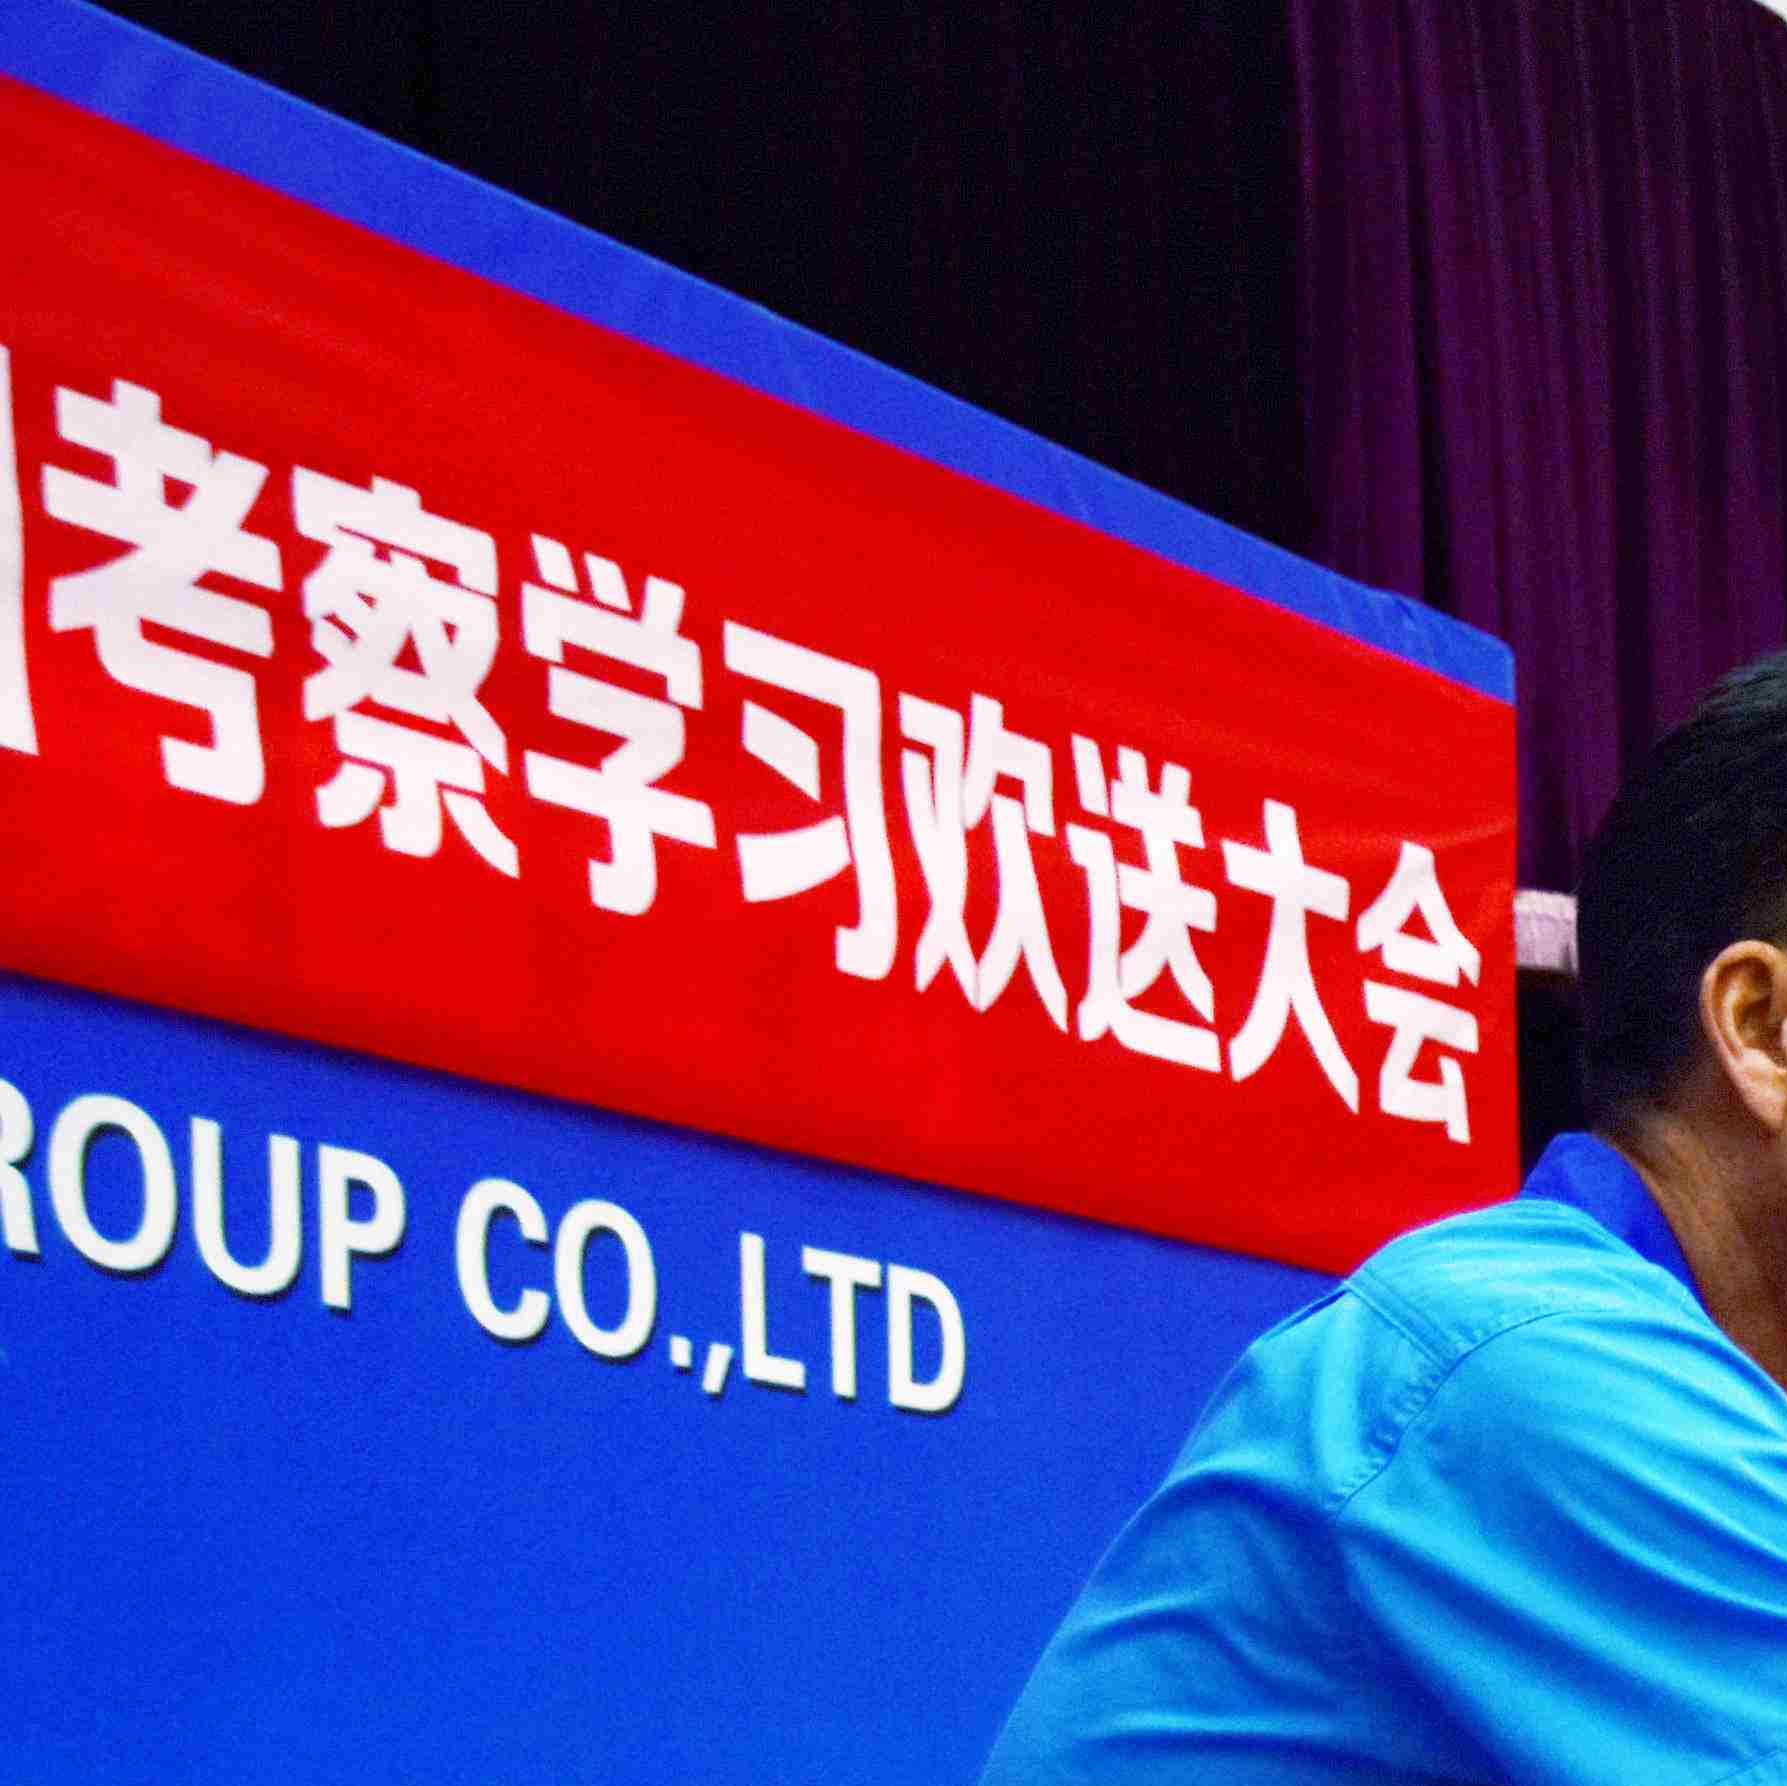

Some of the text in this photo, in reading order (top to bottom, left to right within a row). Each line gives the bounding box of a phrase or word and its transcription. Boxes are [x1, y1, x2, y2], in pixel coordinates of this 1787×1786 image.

[0, 347, 1481, 1143] 考察学习欢送大会
[457, 1178, 965, 1411] CO.,LTD
